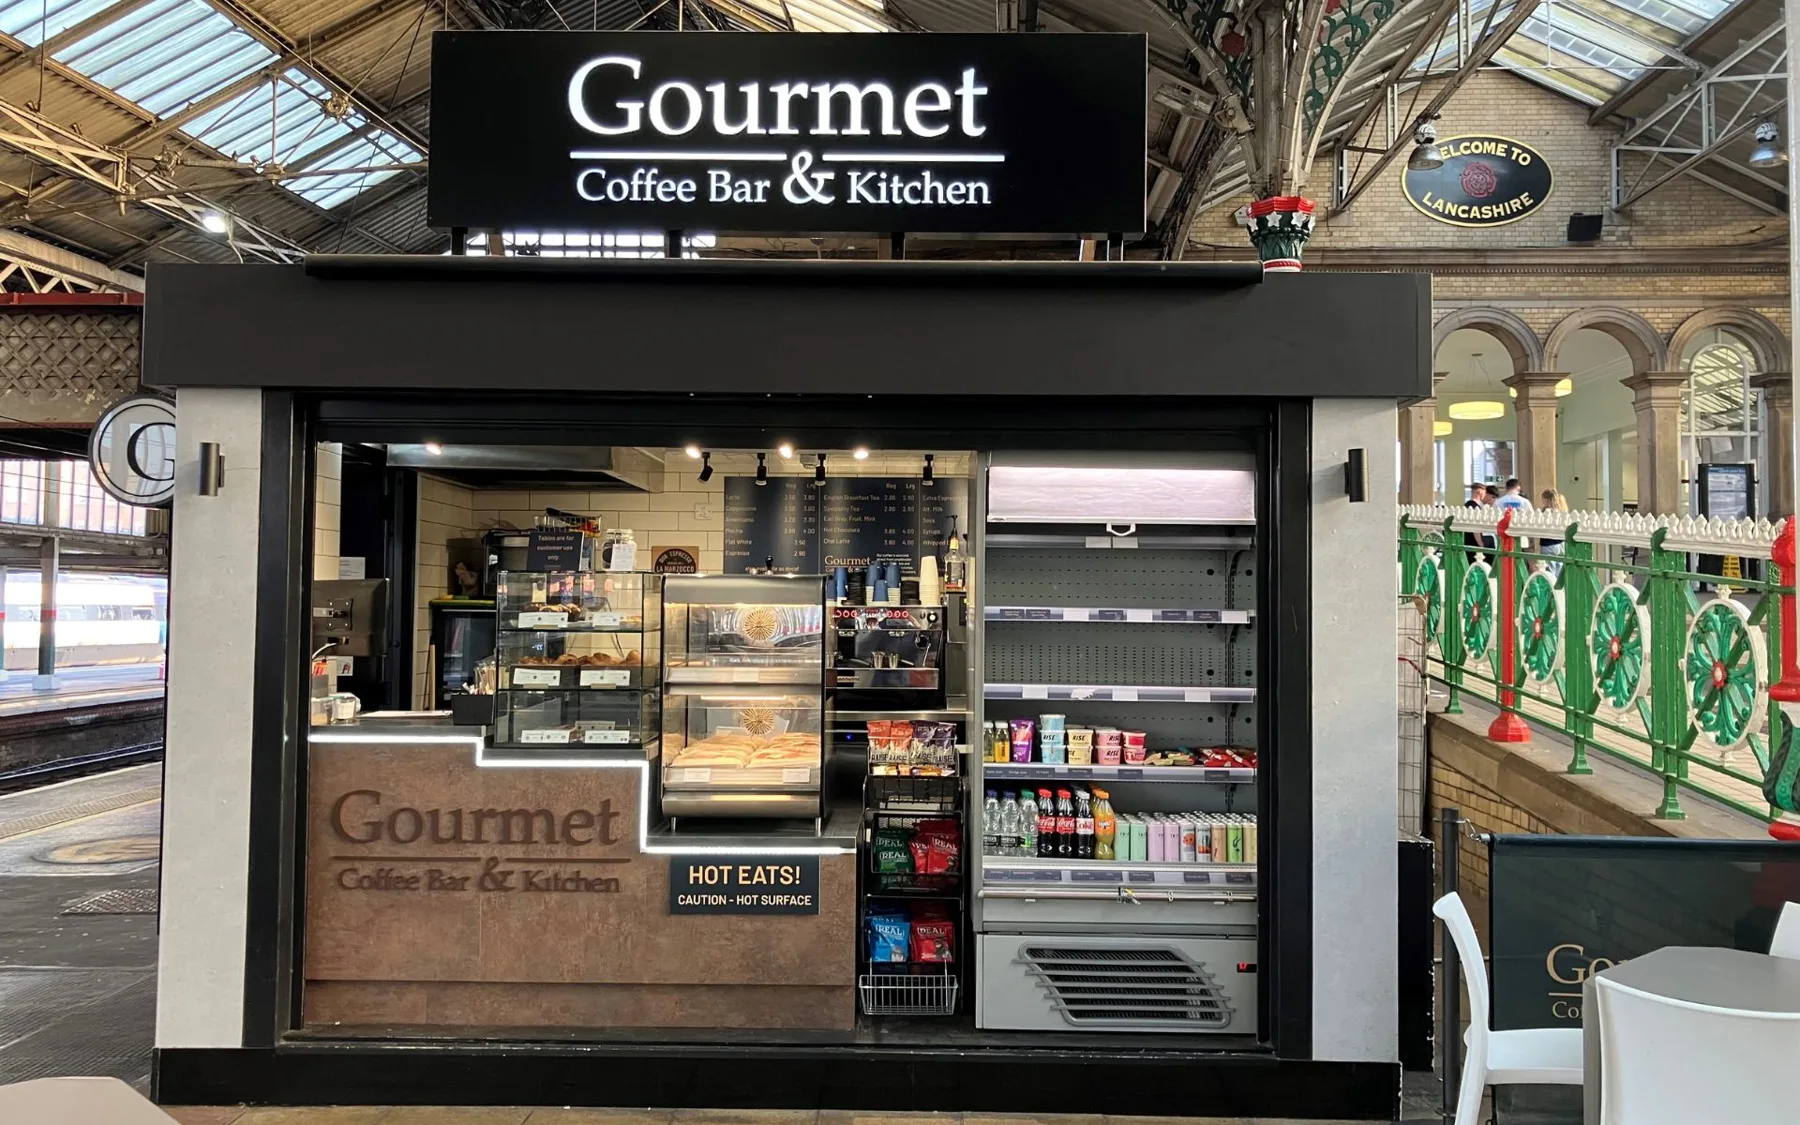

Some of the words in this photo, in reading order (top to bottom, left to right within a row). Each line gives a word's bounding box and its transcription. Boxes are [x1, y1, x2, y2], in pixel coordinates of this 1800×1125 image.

[567, 56, 989, 138] Gourmet
[1440, 141, 1507, 160] ELCOME
[1511, 147, 1532, 166] TO
[576, 167, 697, 204] Coffee
[707, 170, 772, 204] Bar
[782, 150, 836, 206] &
[847, 170, 992, 206] Kitchen
[1421, 191, 1535, 220] LANCASHIRE
[126, 421, 177, 482] G
[824, 555, 870, 566] Gourmet
[330, 788, 621, 847] Gourmet
[878, 838, 902, 847] REAL
[935, 838, 958, 850] REAL
[882, 852, 907, 860] REAL
[336, 868, 420, 893] Coffee
[428, 868, 470, 892] Bar
[478, 856, 520, 892] &
[522, 868, 620, 893] Kitchen
[689, 866, 733, 885] HOT
[738, 866, 801, 885] EATS!
[678, 894, 726, 906] CAUTION
[736, 894, 759, 906] HOT
[762, 894, 812, 906] SURFACE
[878, 925, 902, 935] REAL
